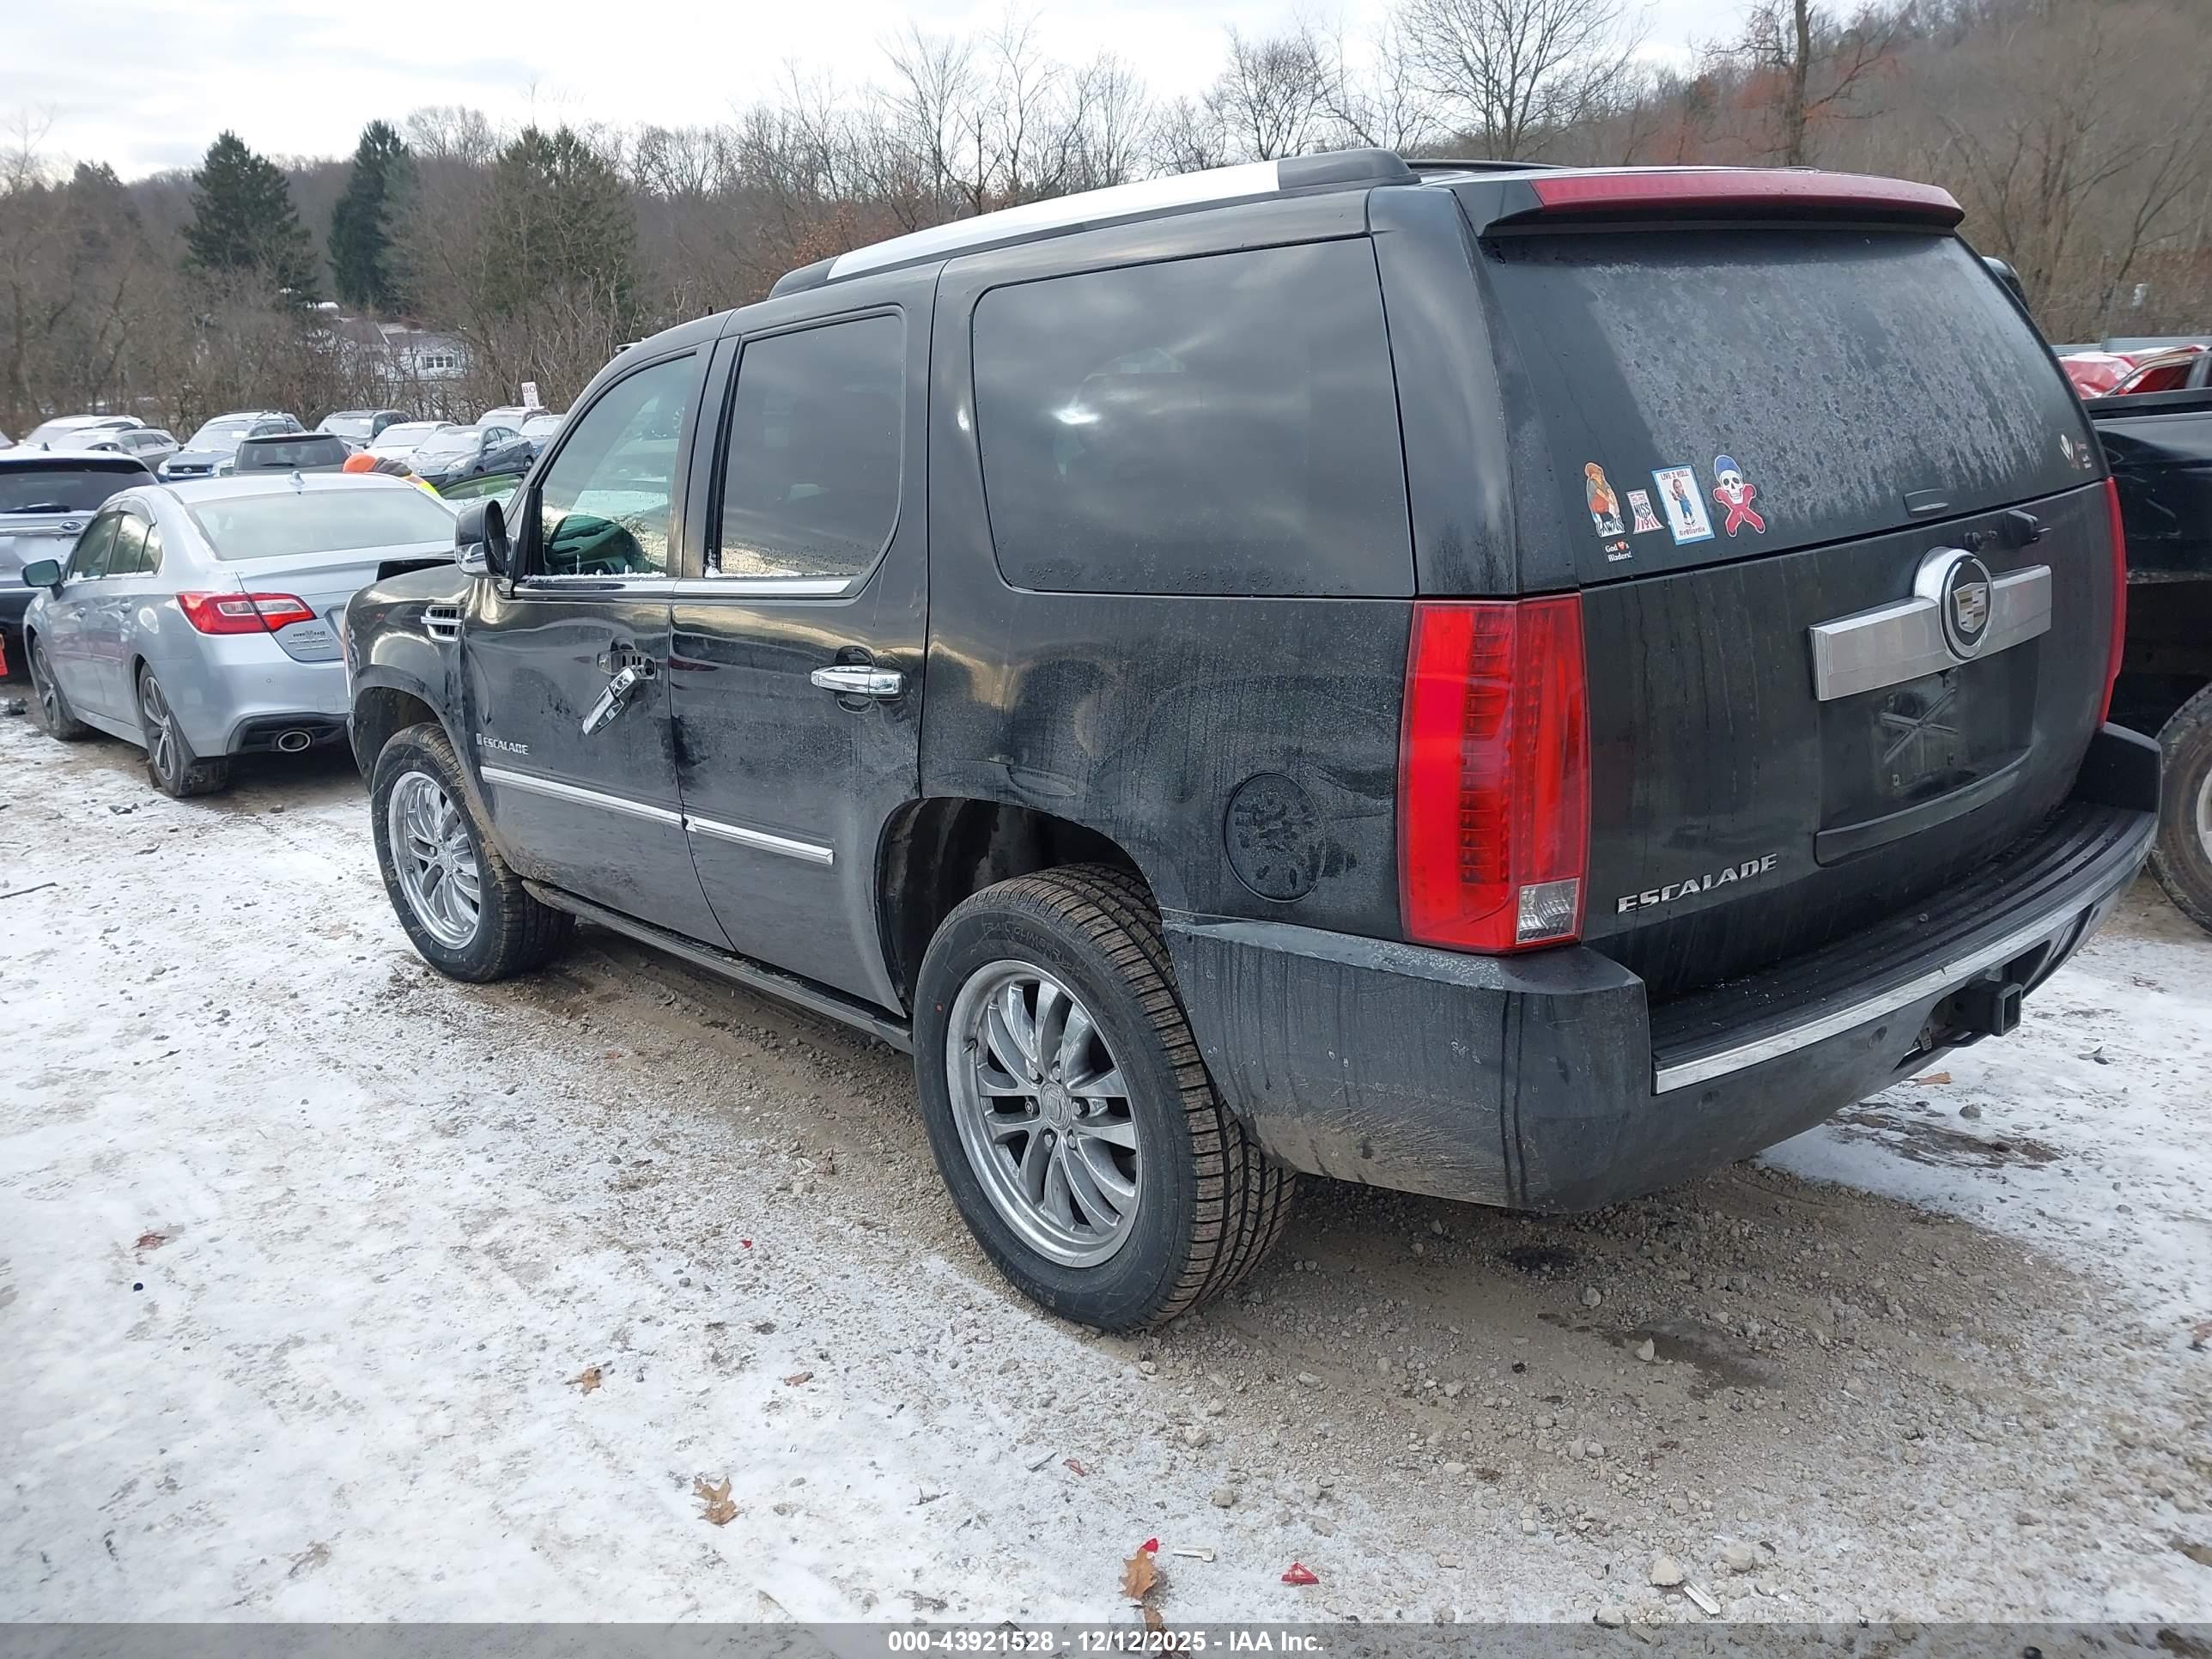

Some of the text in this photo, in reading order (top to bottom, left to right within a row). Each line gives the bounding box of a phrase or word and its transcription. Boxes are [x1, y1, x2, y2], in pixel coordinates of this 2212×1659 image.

[1605, 542, 1619, 552] God
[483, 737, 529, 756] ESCALADE
[1615, 853, 1778, 915] ESCALADE
